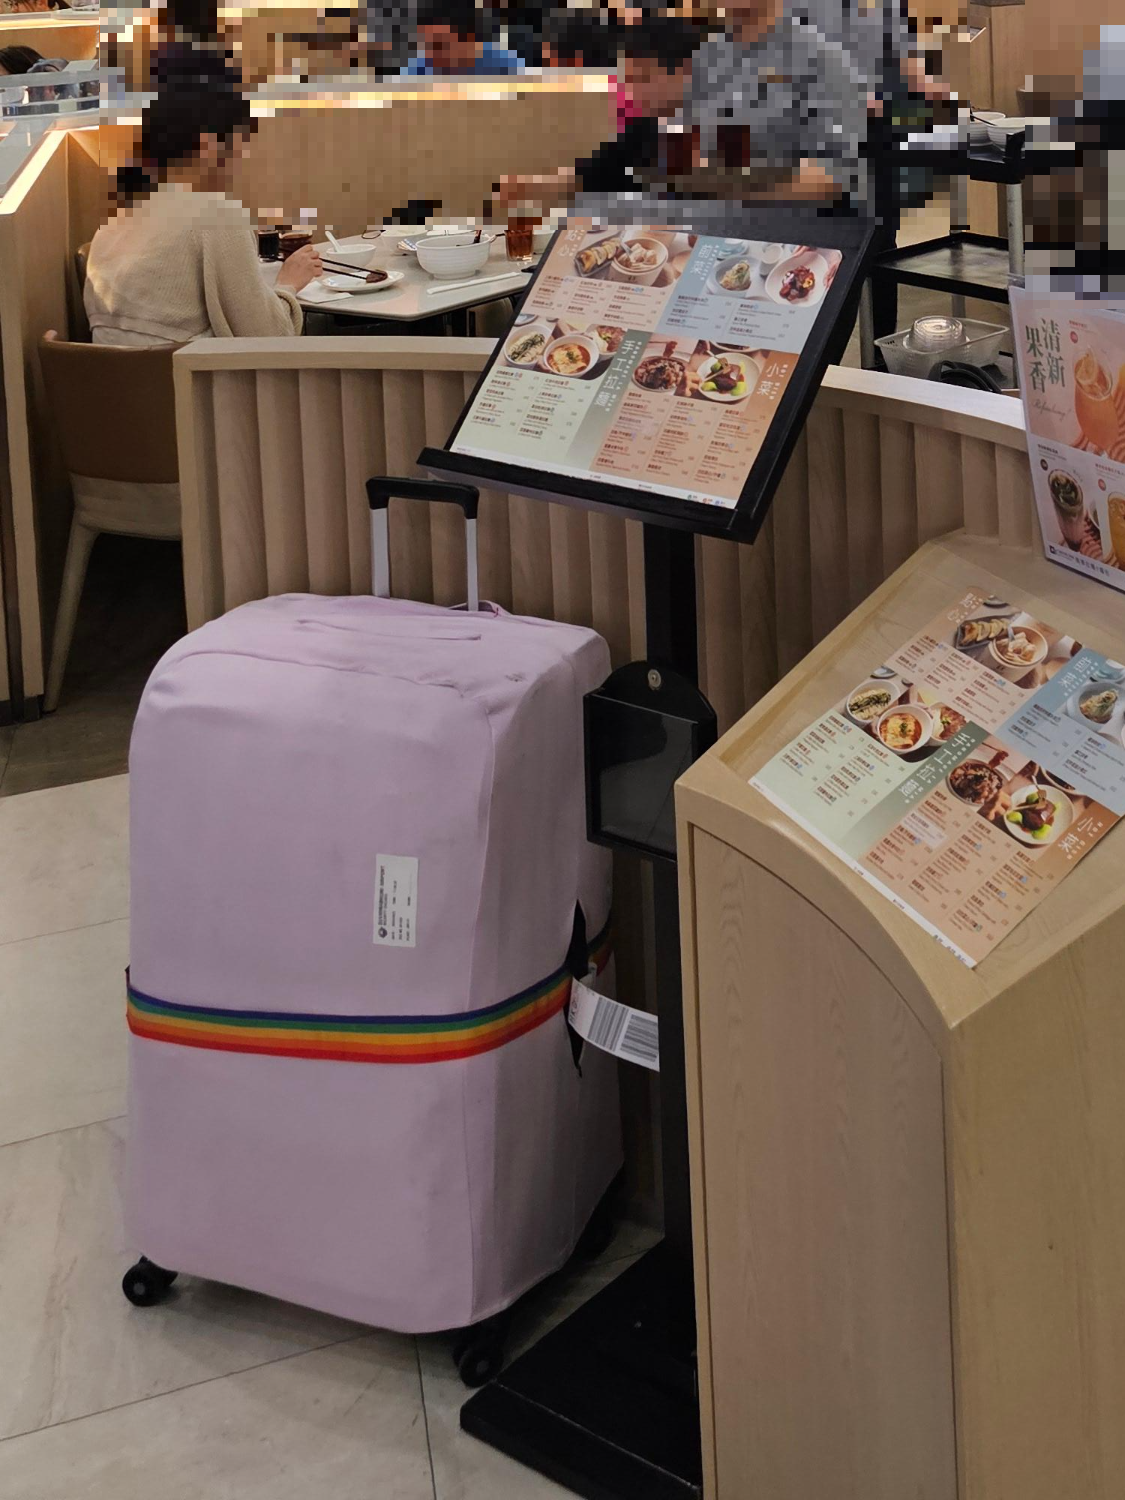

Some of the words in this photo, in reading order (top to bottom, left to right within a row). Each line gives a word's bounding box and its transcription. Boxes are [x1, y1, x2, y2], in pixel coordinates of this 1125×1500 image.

[757, 362, 779, 396] 小菜
[1025, 325, 1046, 393] 果香
[1041, 318, 1065, 388] 清新
[1058, 816, 1094, 853] 小菜
